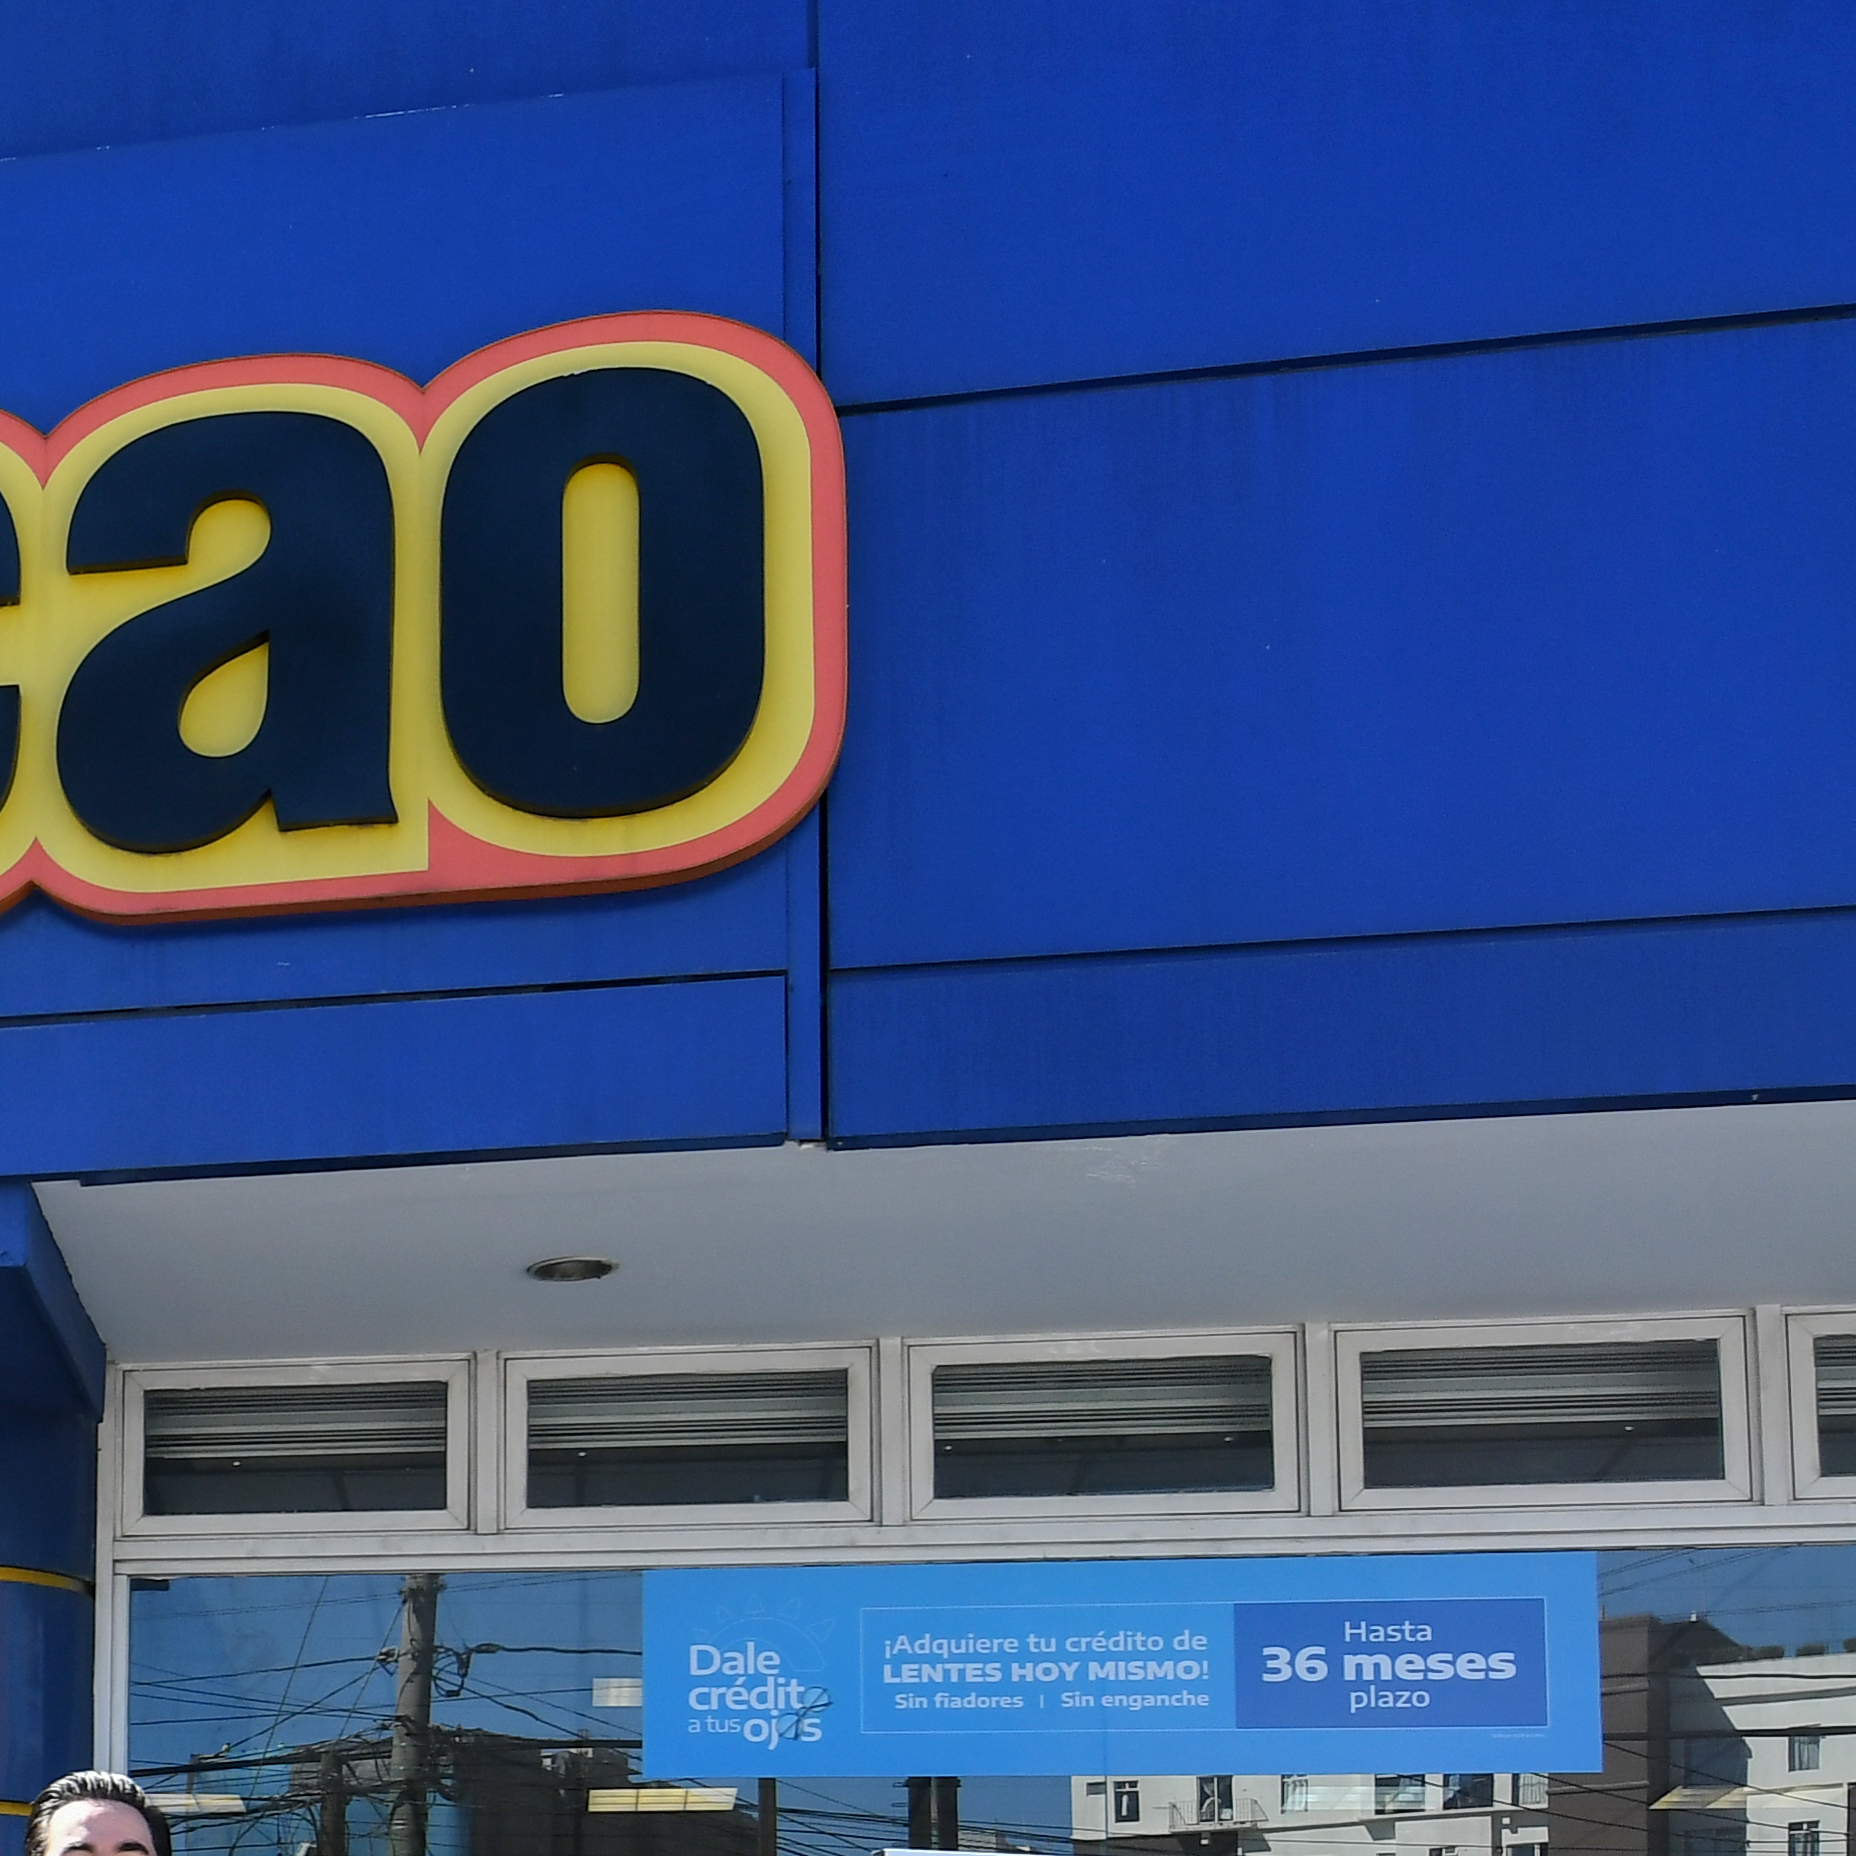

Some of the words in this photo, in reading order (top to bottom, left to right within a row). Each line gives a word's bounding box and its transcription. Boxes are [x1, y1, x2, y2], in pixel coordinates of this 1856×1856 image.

[1344, 1620, 1433, 1642] Hasta
[884, 1633, 1019, 1659] ¡Adquiere
[1027, 1634, 1057, 1653] tu
[1065, 1631, 1164, 1652] crédito
[1172, 1630, 1208, 1651] de
[689, 1641, 781, 1676] Dale
[1261, 1646, 1328, 1682] 36
[1343, 1651, 1517, 1681] meses
[883, 1662, 1003, 1684] LENTES
[1011, 1662, 1081, 1683] HOY
[1088, 1660, 1210, 1682] MISMO!
[894, 1693, 928, 1709] Sin
[933, 1692, 1024, 1709] fiadores
[1061, 1691, 1095, 1708] Sin
[1101, 1690, 1210, 1711] enganche
[1350, 1685, 1431, 1714] plazo
[688, 1718, 701, 1733] a
[705, 1716, 741, 1733] tus
